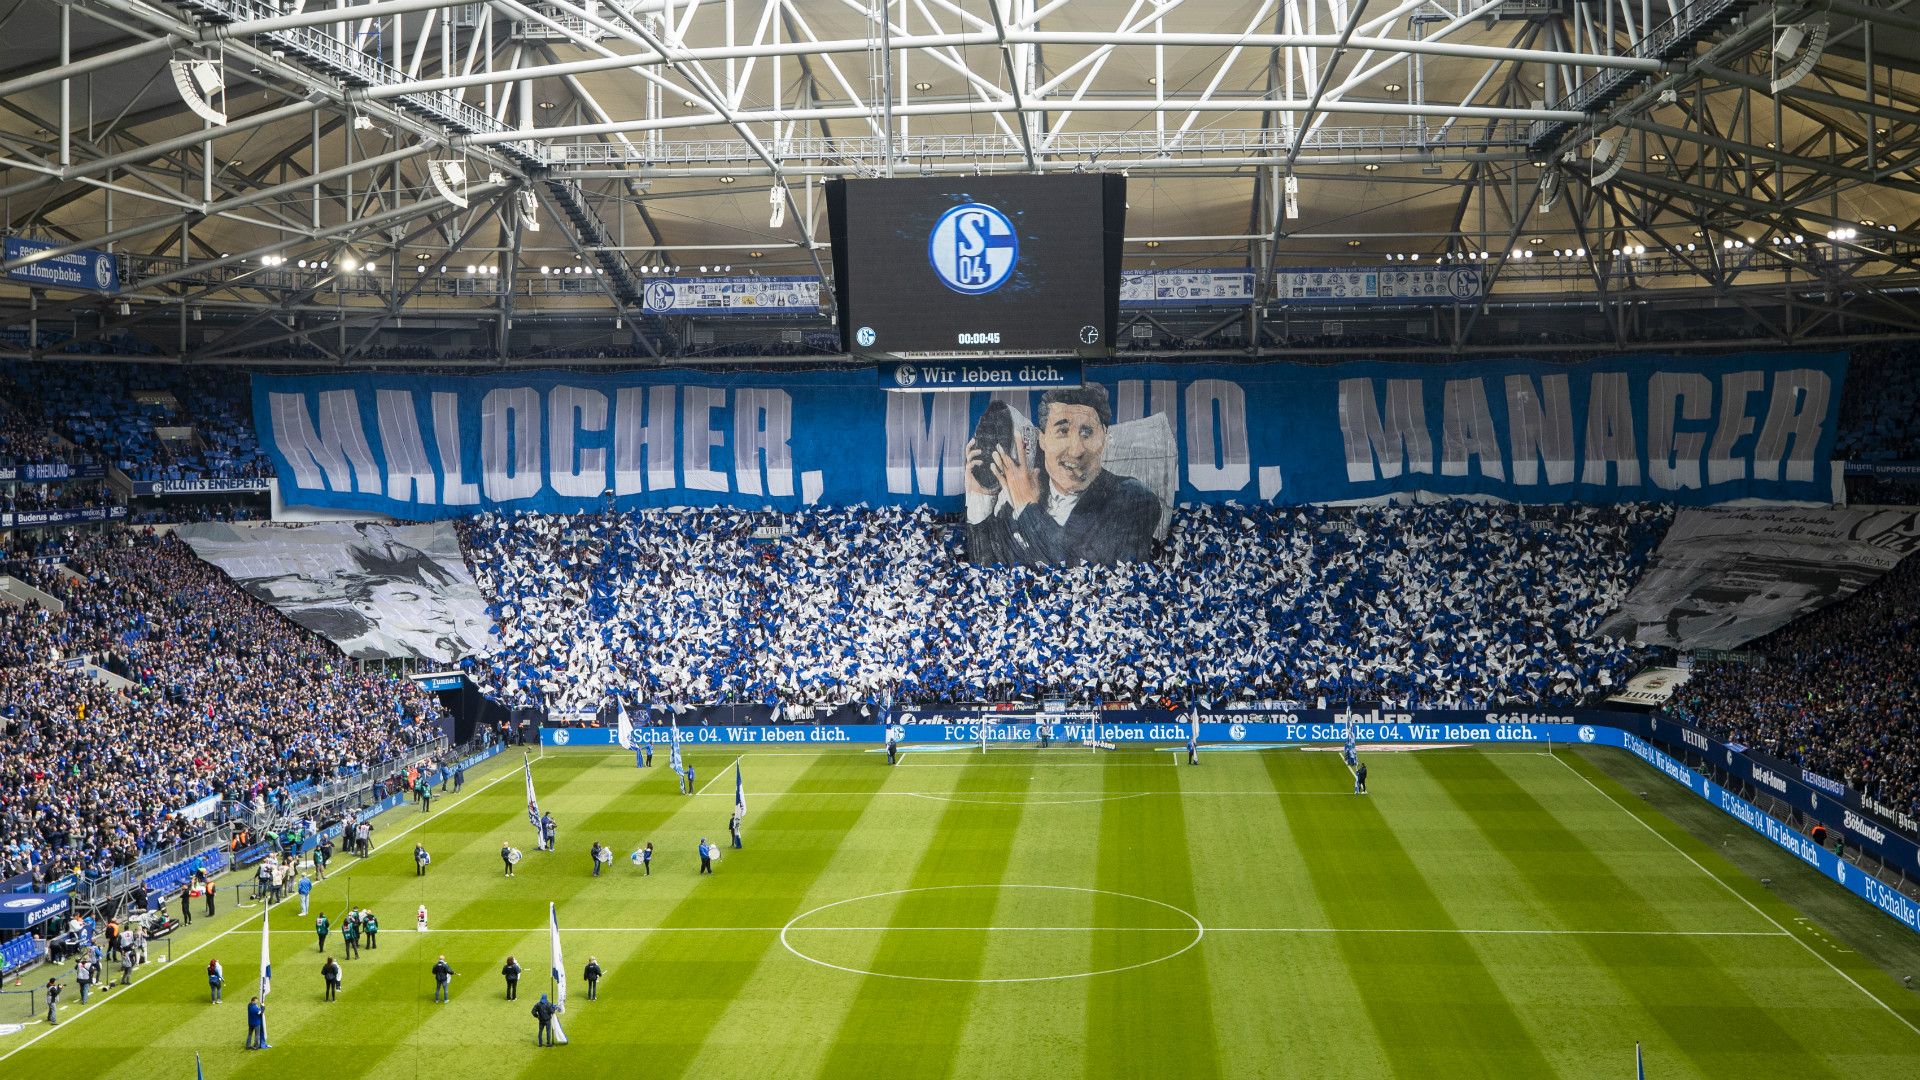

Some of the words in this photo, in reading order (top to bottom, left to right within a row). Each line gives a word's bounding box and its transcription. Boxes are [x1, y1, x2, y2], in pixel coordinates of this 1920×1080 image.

[31, 264, 81, 282] Homophobie
[958, 333, 1001, 344] 00:00:45
[922, 366, 955, 383] Wir
[962, 365, 1013, 383] leben
[1019, 363, 1064, 383] dich.
[1338, 369, 1832, 491] MANAGER
[36, 464, 68, 478] RHEINLAND
[208, 478, 270, 489] ENNEPETAL
[18, 513, 47, 523] Buderus
[1854, 555, 1890, 567] ARENA
[432, 677, 456, 685] Tunnel
[1615, 690, 1668, 700] ELTINS
[699, 728, 722, 742] 04.
[726, 727, 756, 742] Wir
[761, 727, 805, 742] leben
[810, 726, 850, 741] dich.
[945, 726, 964, 740] FC
[969, 725, 1030, 740] Schalke
[1064, 725, 1096, 740] Wir
[1100, 725, 1144, 739] leben
[1150, 725, 1190, 739] dich.
[1286, 725, 1307, 739] FC
[1311, 724, 1374, 740] Schake
[1379, 725, 1403, 740] 04.
[1408, 725, 1440, 740] Wir
[1444, 724, 1490, 740] leben
[1495, 724, 1537, 740] dich.
[1682, 728, 1708, 751] VELTINS
[1623, 732, 1631, 748] FC
[1679, 765, 1693, 788] dich.
[1802, 769, 1839, 794] FLENSBURG
[1721, 790, 1730, 811] FC
[1730, 796, 1755, 826] Schalke
[1755, 811, 1765, 833] 04.
[1766, 816, 1779, 841] Wir
[1779, 825, 1800, 855] leben
[1800, 838, 1820, 867] dich.
[1865, 876, 1877, 903] FC
[1878, 884, 1915, 926] Schalke
[41, 902, 61, 917] Schalke
